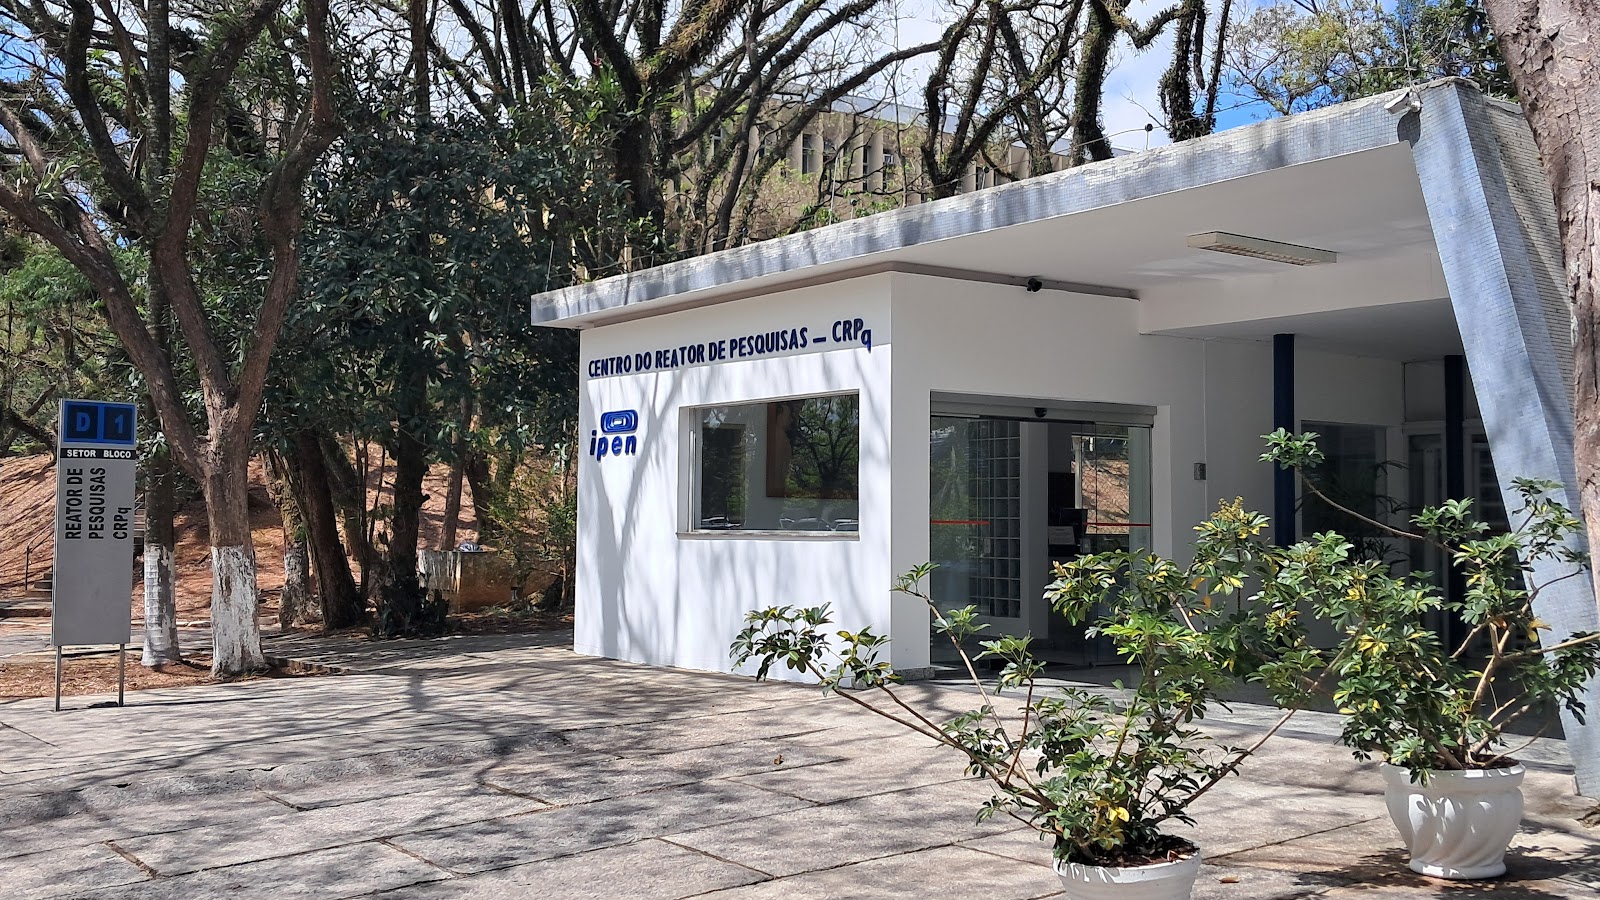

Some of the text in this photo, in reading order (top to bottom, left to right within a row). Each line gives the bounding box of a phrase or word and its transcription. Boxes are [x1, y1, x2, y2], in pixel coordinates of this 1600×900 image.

[588, 357, 632, 378] CENTRO
[635, 351, 652, 372] DO
[655, 344, 705, 369] REATOR
[709, 341, 726, 362] DE
[730, 327, 808, 359] PESQUISAS
[832, 318, 872, 352] CRPq
[76, 412, 124, 434] D 1
[66, 449, 132, 459] SETOR BLOCO
[590, 430, 637, 461] ipen
[65, 468, 83, 540] REATOR DE
[89, 467, 106, 540] PESQUISAS
[112, 507, 132, 540] CRPq
